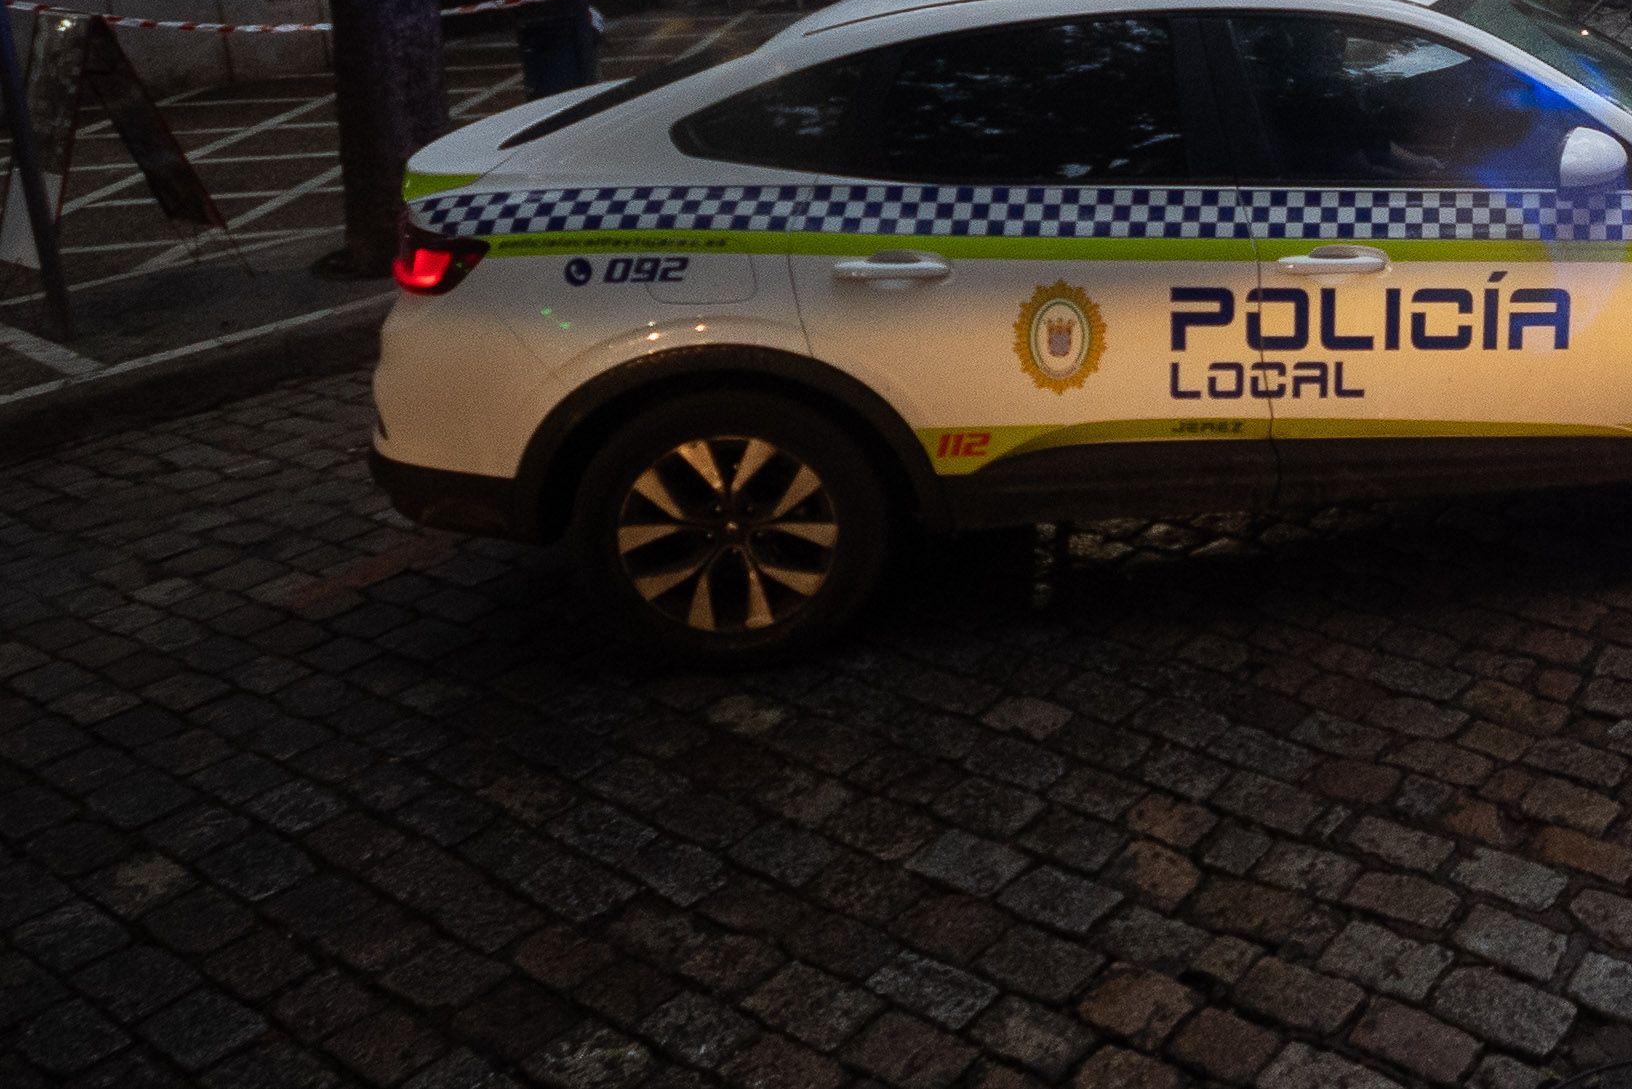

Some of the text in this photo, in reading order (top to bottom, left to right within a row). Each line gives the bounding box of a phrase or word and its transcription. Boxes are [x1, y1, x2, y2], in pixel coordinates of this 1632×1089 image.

[603, 256, 690, 284] 092
[1170, 271, 1571, 351] POLICÍA
[1170, 361, 1366, 400] LOCAL
[936, 433, 991, 458] 112
